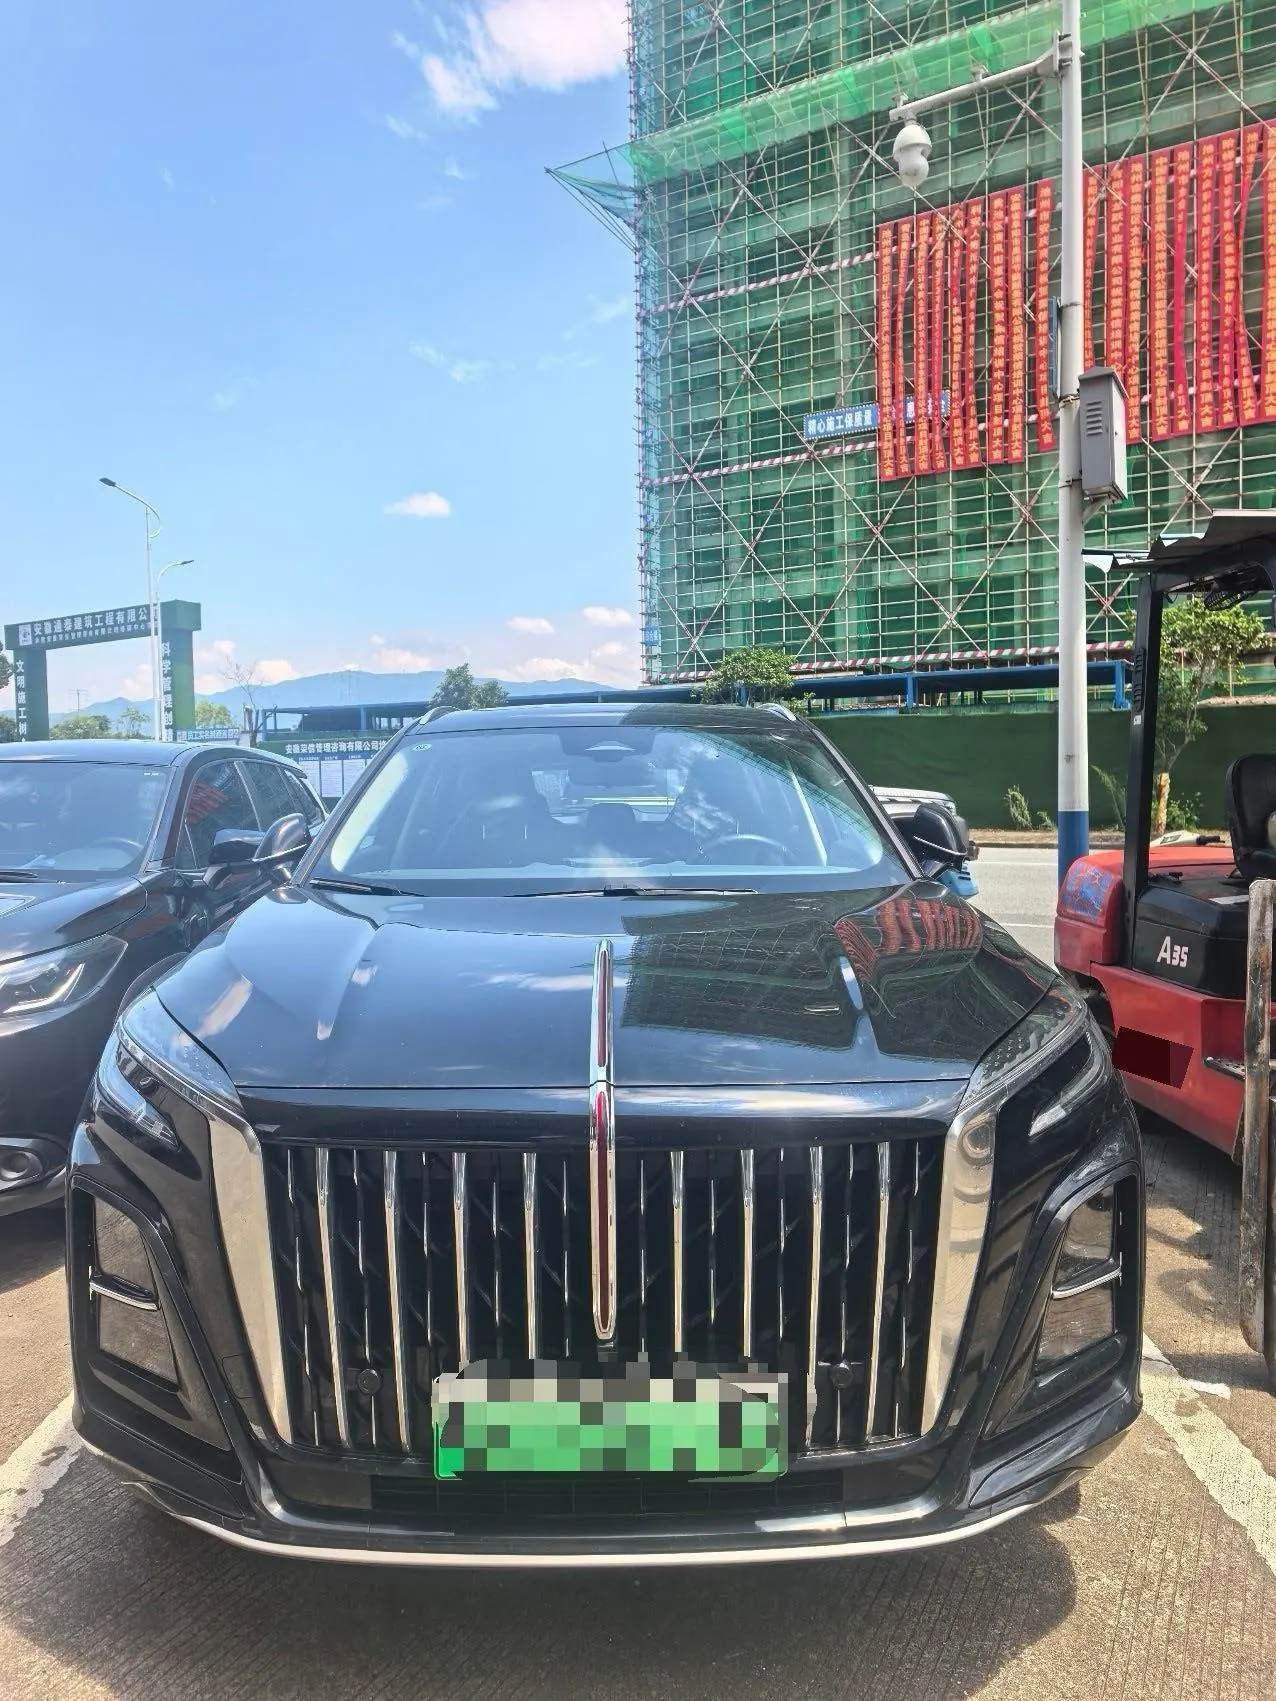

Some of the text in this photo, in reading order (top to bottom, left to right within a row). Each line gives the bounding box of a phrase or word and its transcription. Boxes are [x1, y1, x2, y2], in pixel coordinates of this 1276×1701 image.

[807, 409, 873, 435] 精心施工保质量
[33, 606, 157, 636] 安徽通泰建筑工程有限公
[15, 659, 28, 742] 文明施工树
[1156, 935, 1190, 968] A35
